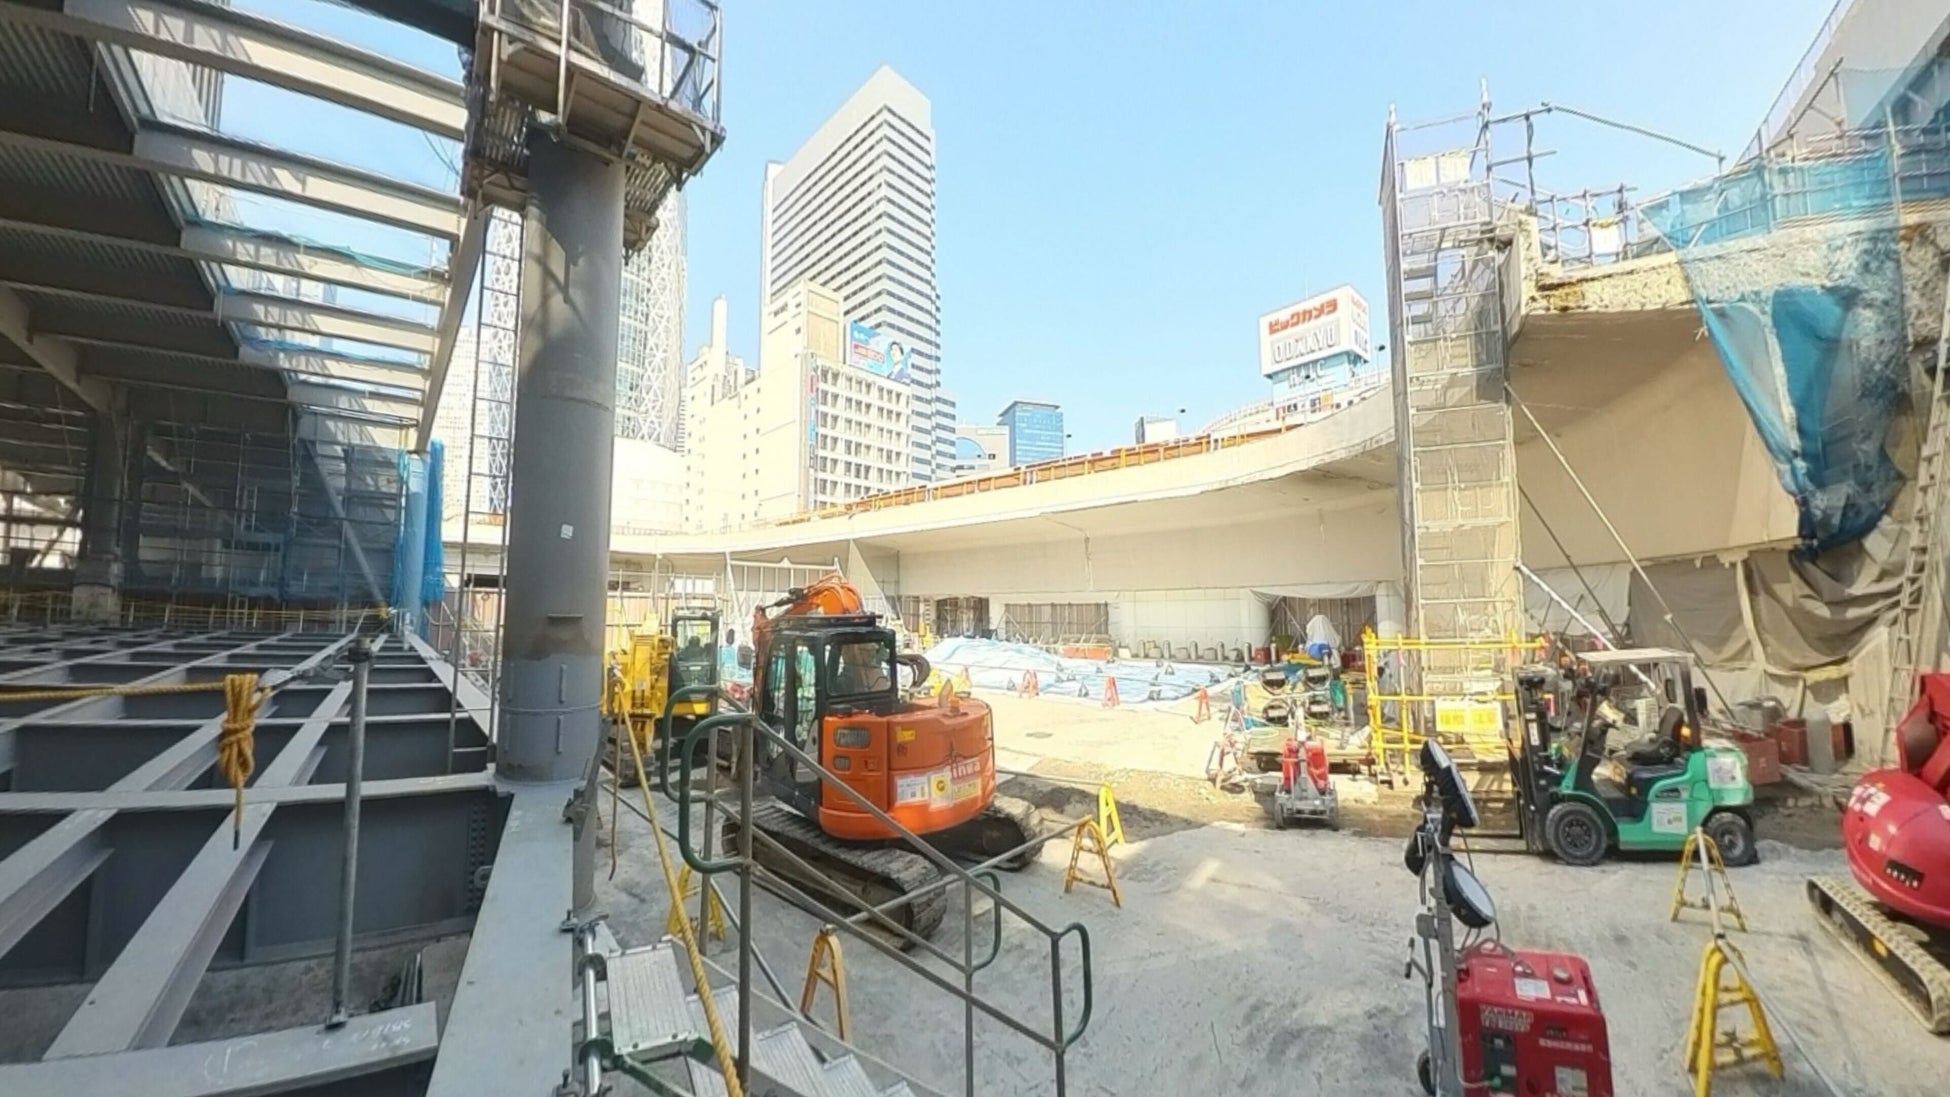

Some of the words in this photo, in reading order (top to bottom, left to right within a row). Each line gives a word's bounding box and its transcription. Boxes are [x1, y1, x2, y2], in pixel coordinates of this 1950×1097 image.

[1269, 298, 1338, 335] ビックカメラ
[1273, 324, 1337, 364] ODAKYU
